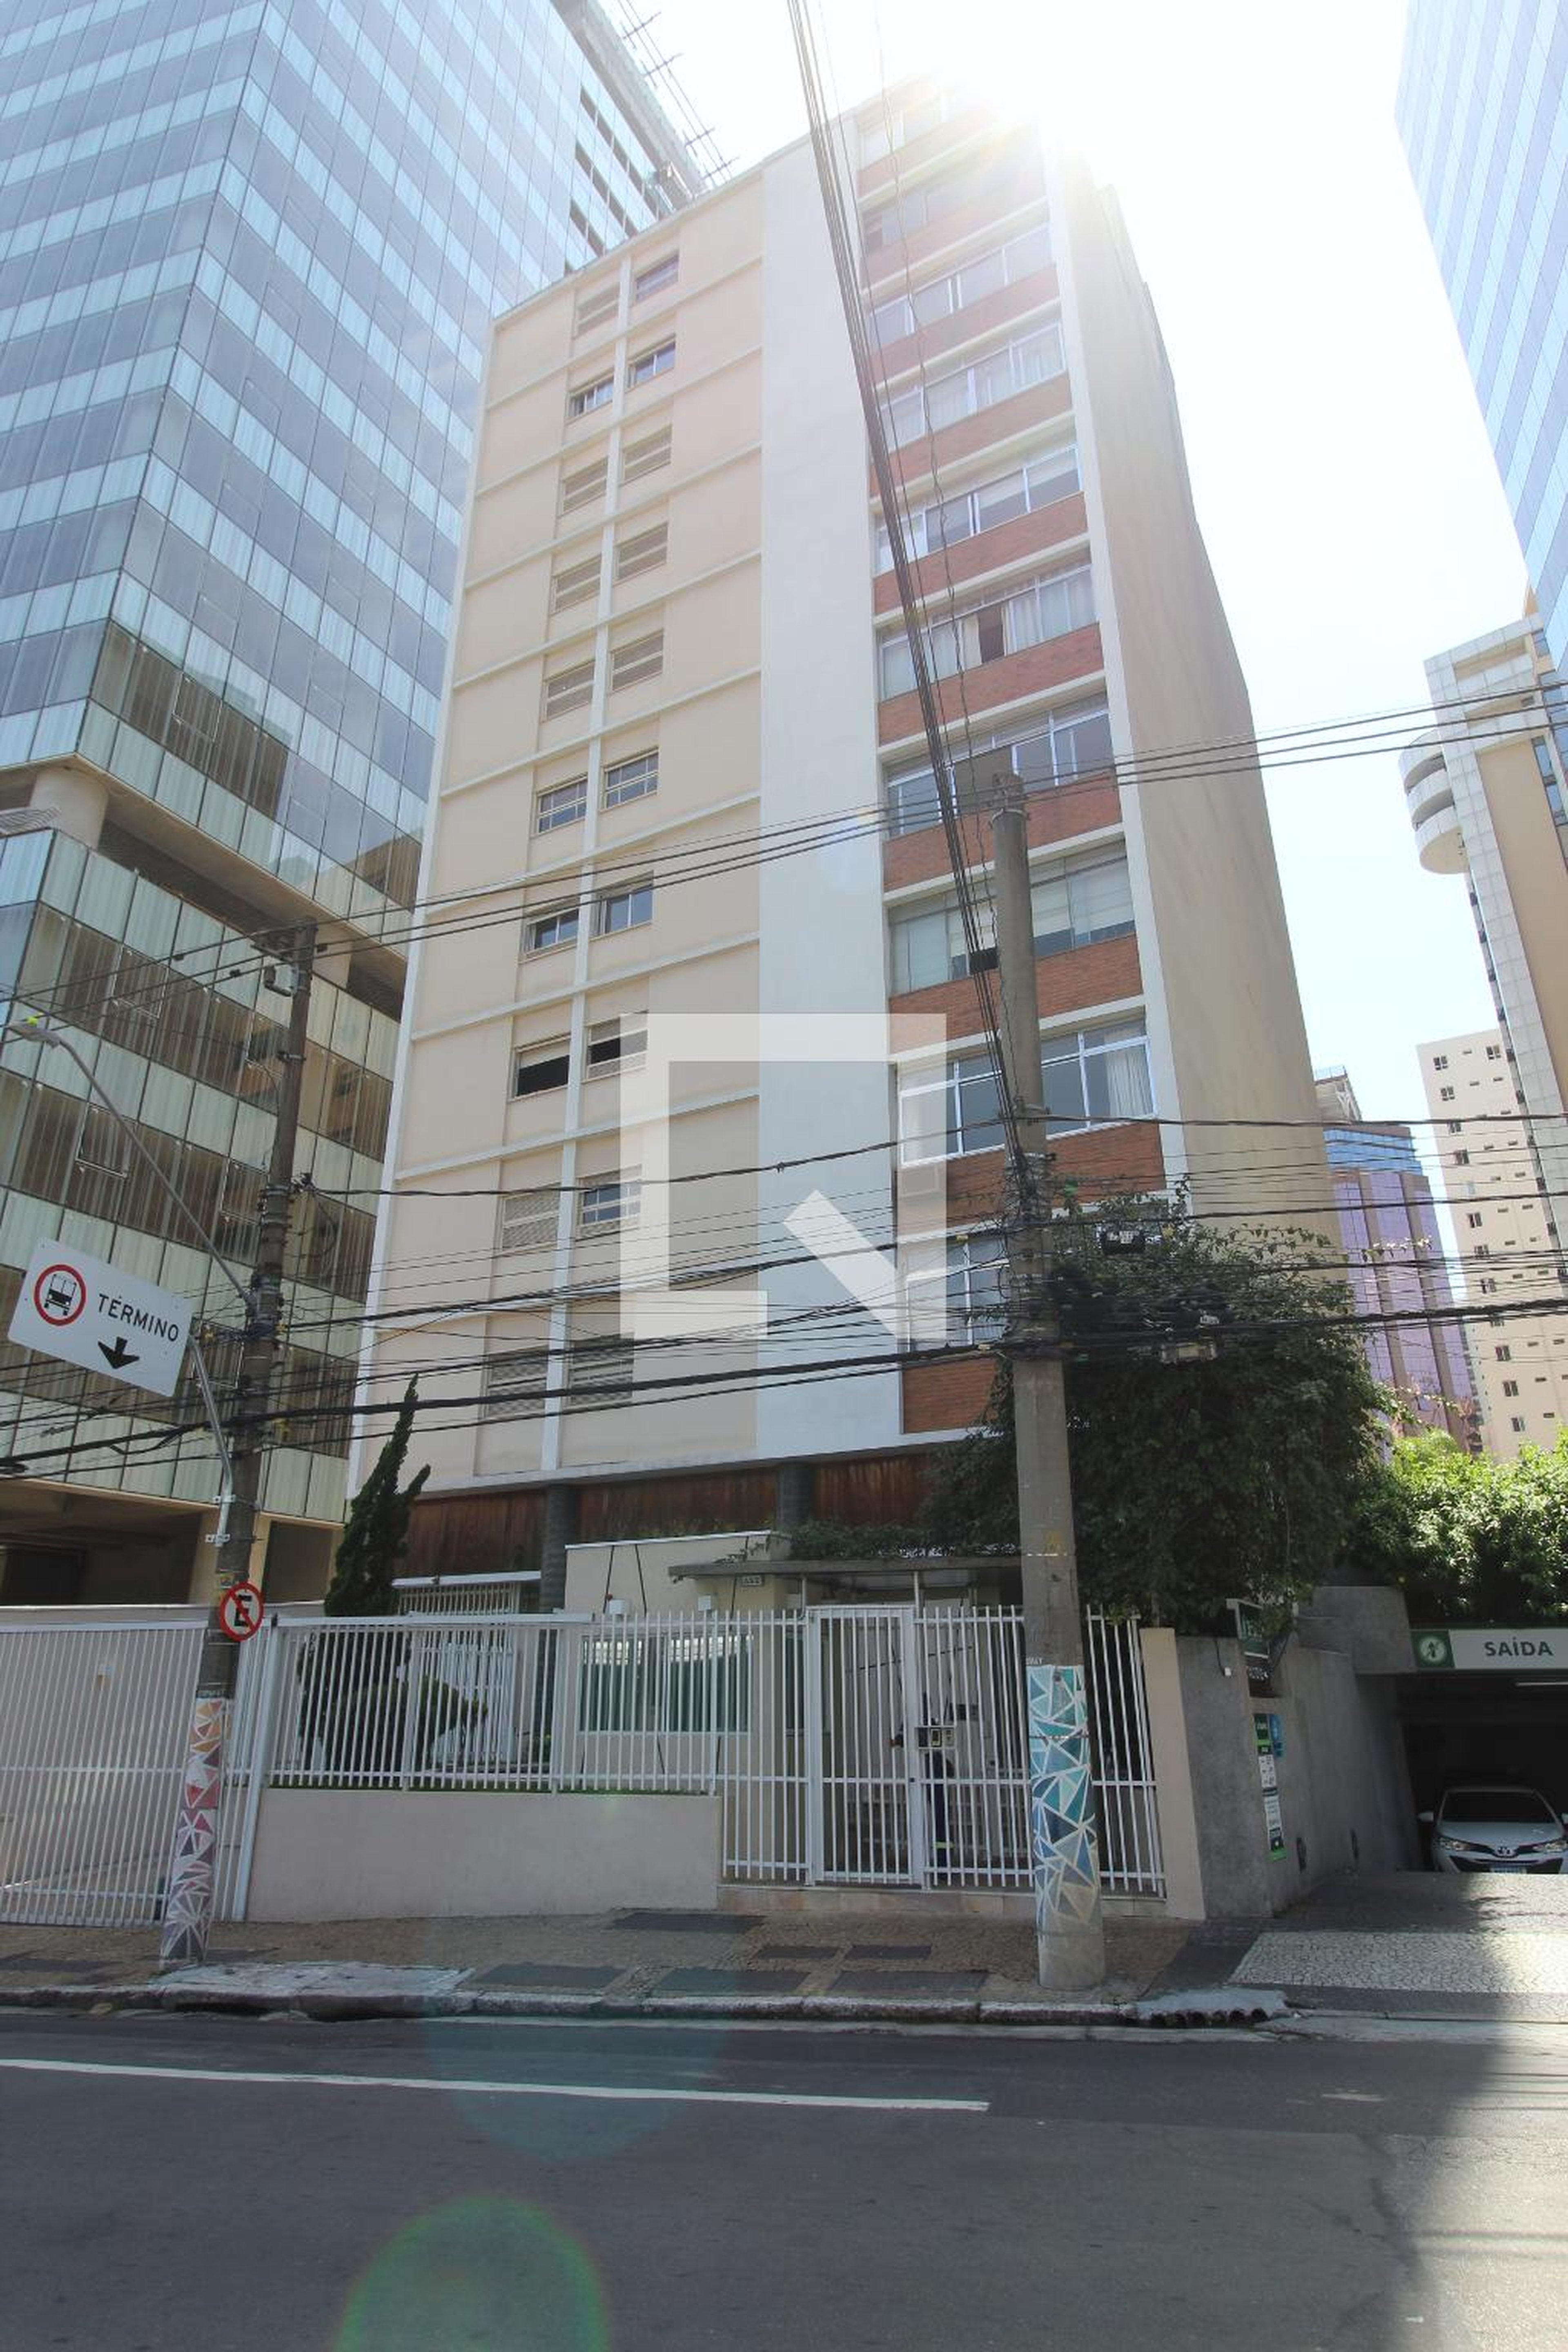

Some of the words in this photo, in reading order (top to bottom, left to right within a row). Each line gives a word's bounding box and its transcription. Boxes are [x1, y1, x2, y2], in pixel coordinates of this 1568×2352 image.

[99, 1293, 178, 1342] TÉRMINO
[234, 1594, 252, 1627] E
[1484, 1636, 1554, 1657] SAÍDA
